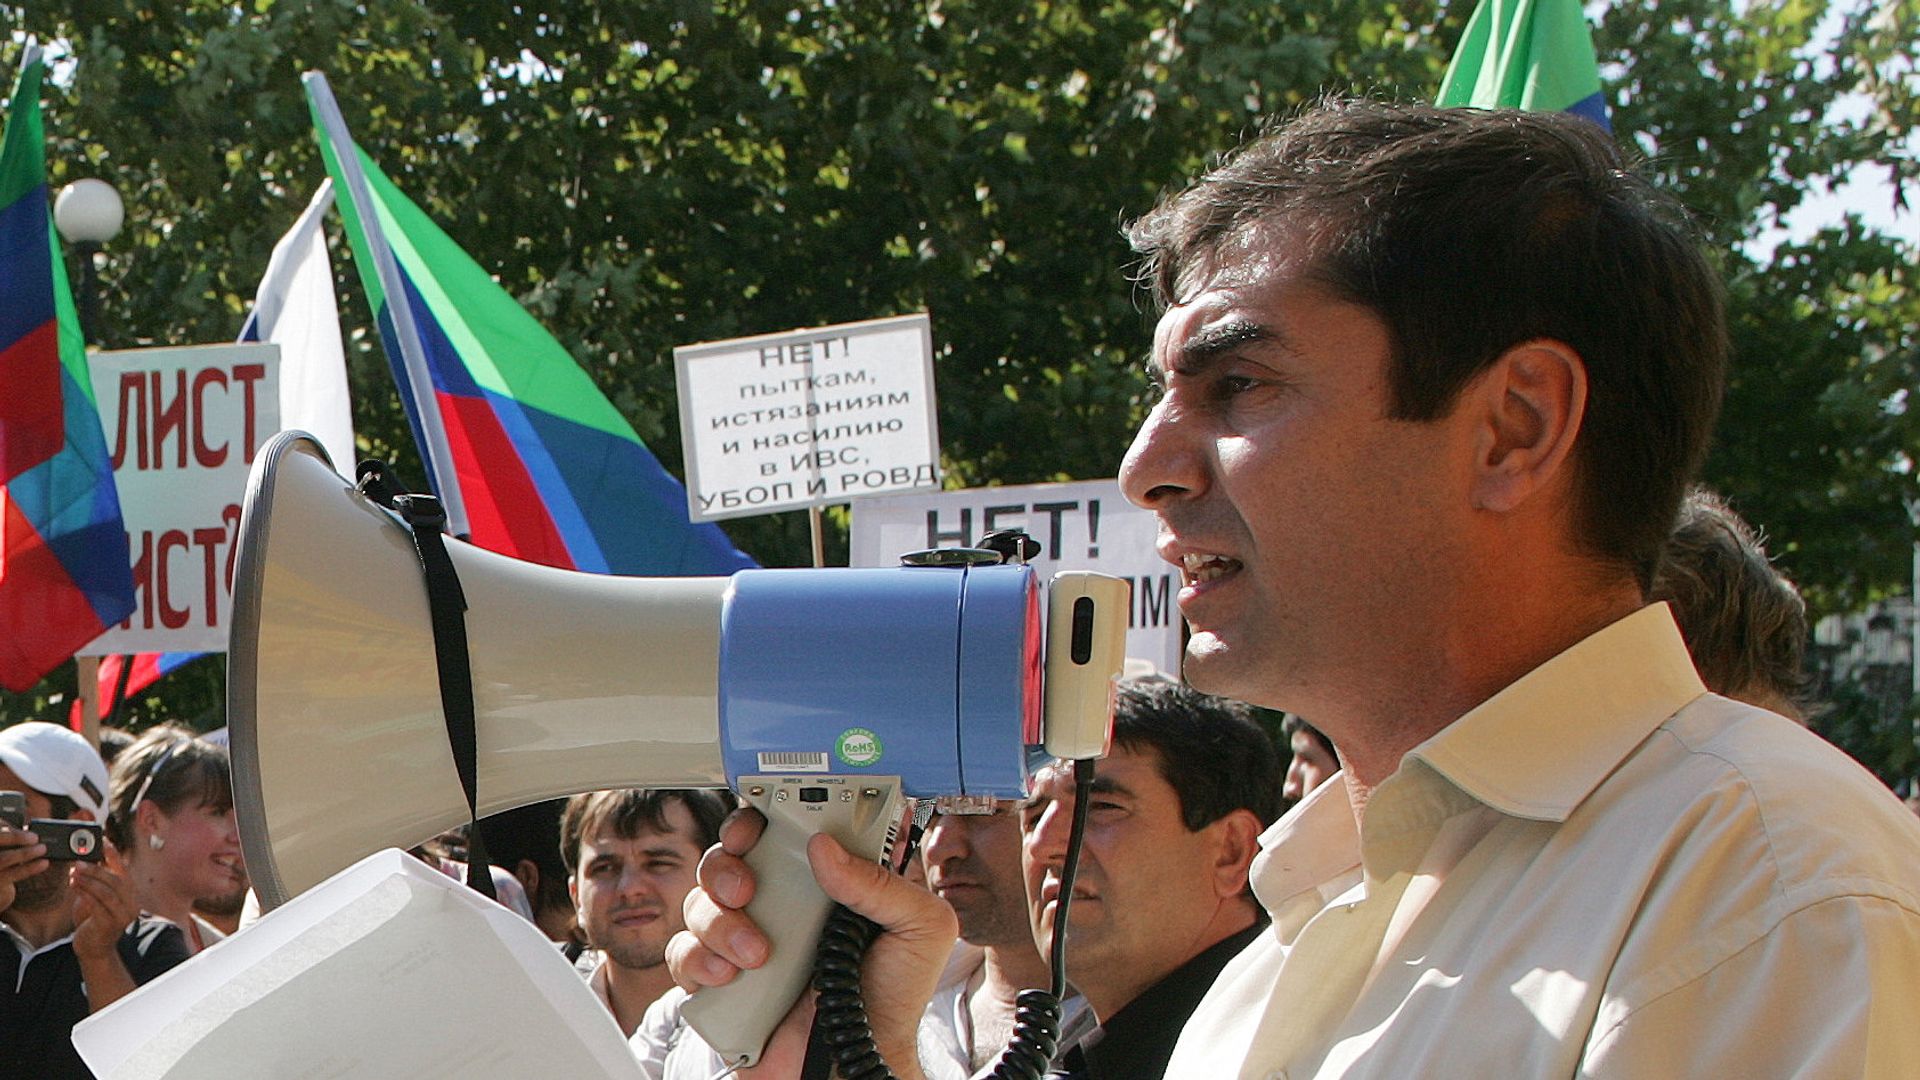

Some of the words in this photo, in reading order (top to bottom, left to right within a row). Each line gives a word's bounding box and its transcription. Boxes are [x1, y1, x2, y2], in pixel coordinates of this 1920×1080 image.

[759, 336, 849, 368] НЕТ!
[740, 369, 876, 398] пыткам,
[711, 391, 909, 429] истязаниям
[722, 440, 739, 454] и
[753, 418, 903, 450] насилию
[760, 462, 777, 476] в
[791, 446, 869, 471] ИВС,
[697, 482, 793, 511] УБОП
[807, 478, 827, 496] И
[842, 464, 938, 491] РОВД
